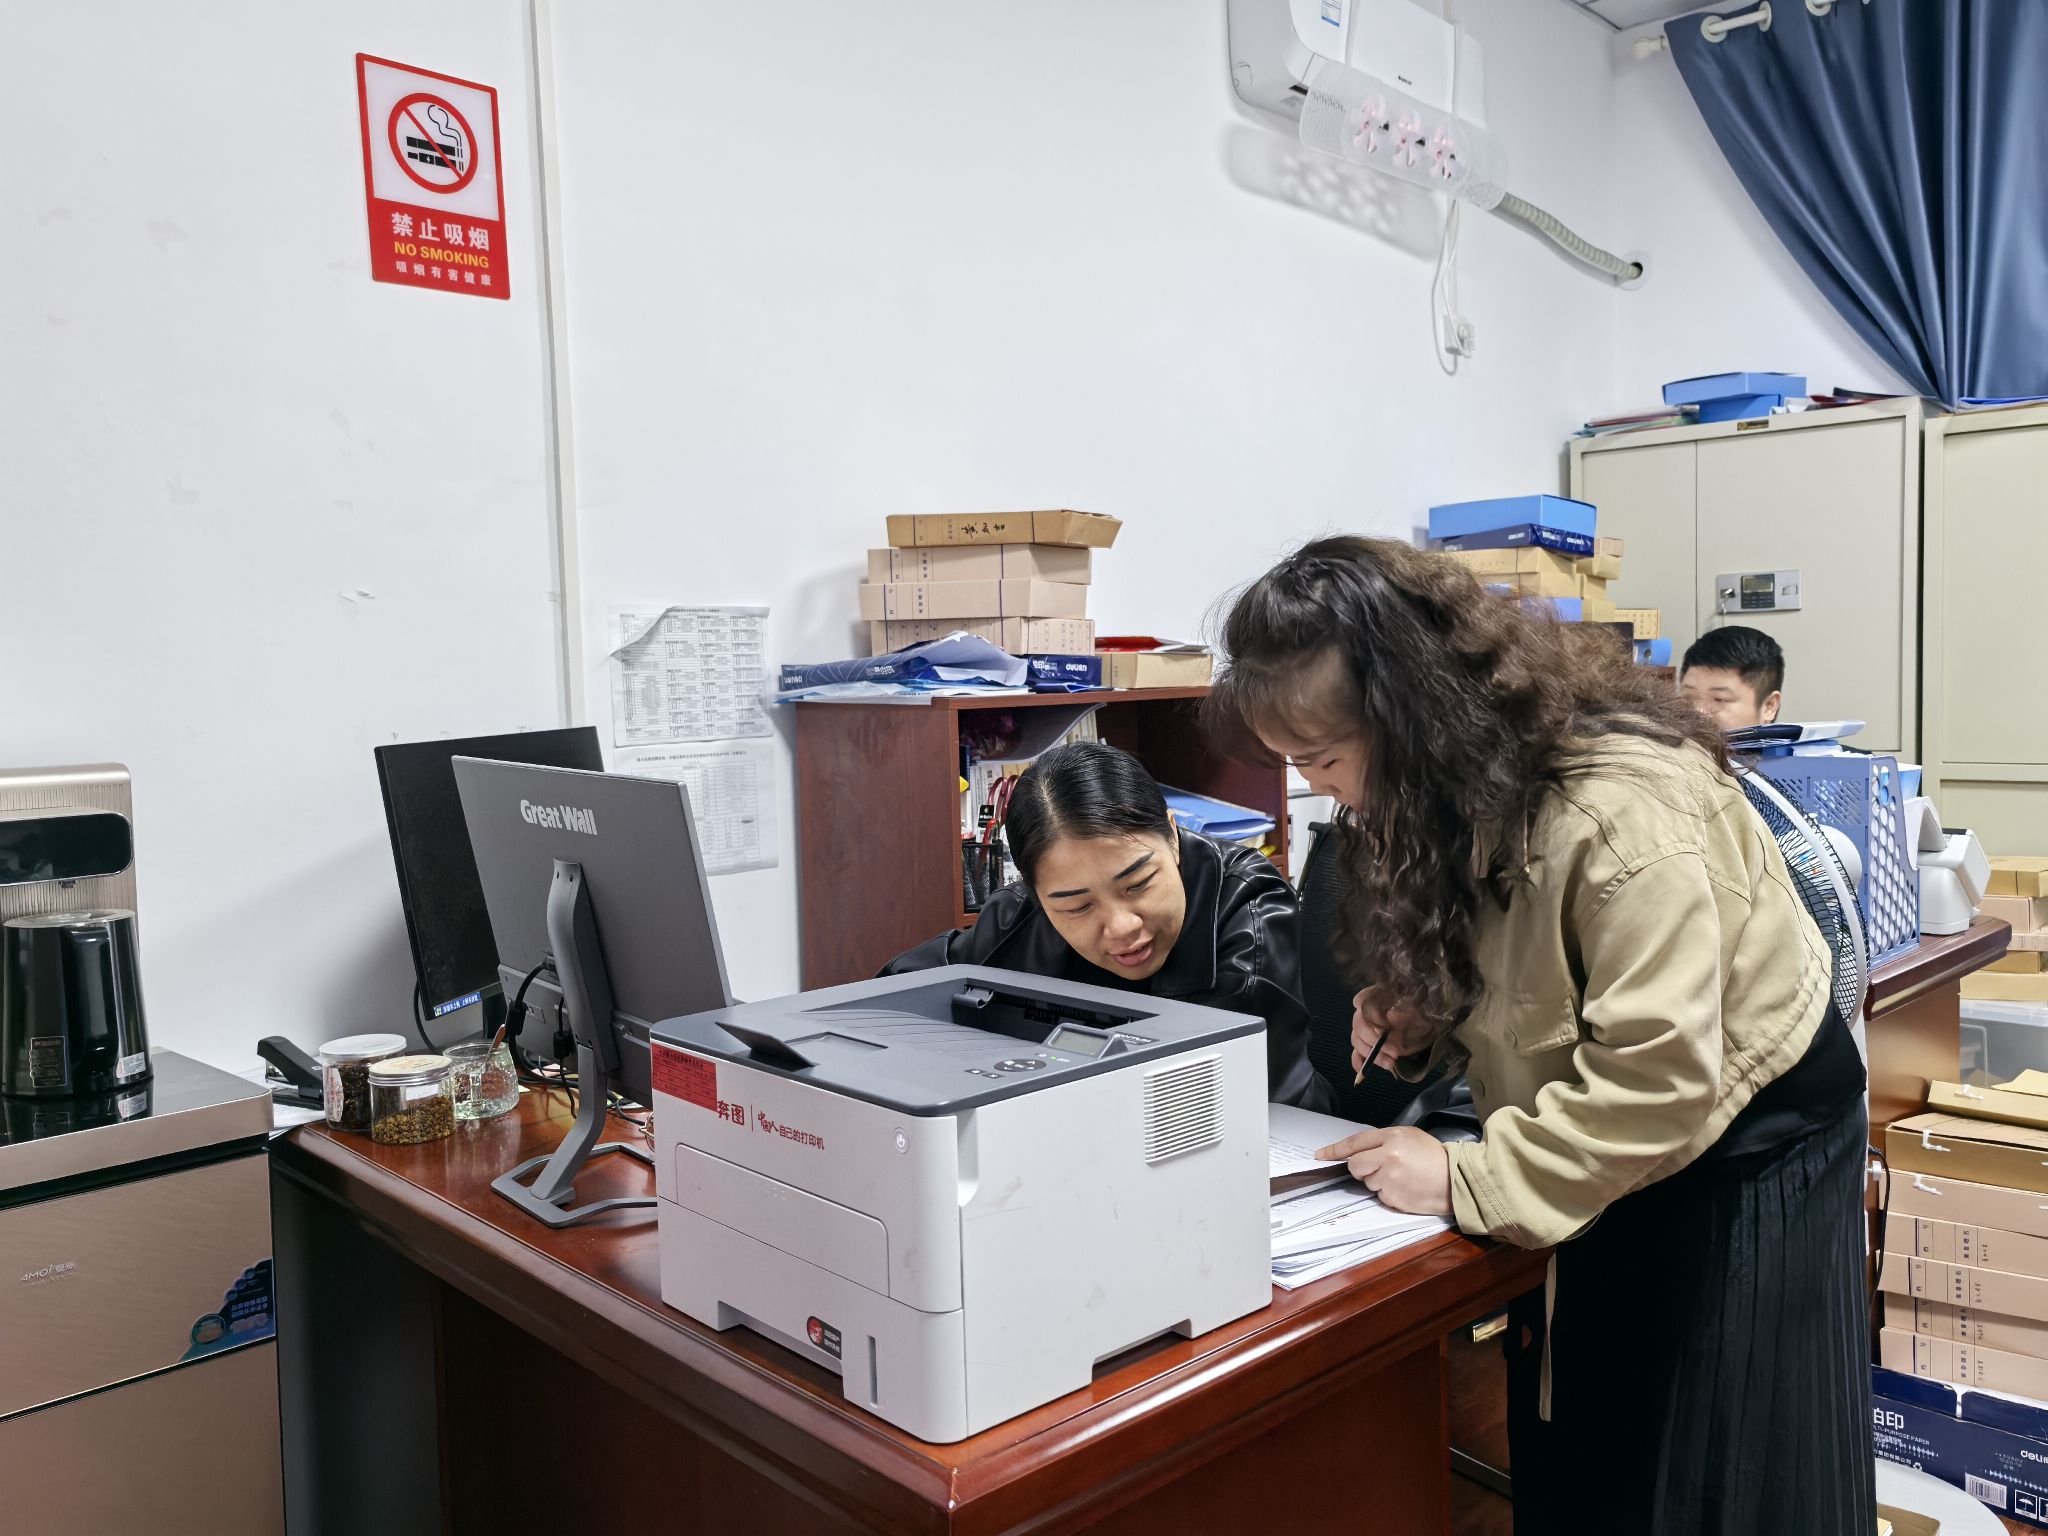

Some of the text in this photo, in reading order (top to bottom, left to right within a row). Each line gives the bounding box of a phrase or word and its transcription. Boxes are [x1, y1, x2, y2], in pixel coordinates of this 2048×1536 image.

[391, 211, 490, 252] 禁止吸烟
[394, 241, 490, 268] NO SMOKING
[395, 260, 492, 286] 吸烟有害健康
[520, 799, 598, 835] Great Wall
[717, 1100, 745, 1126] 奔图
